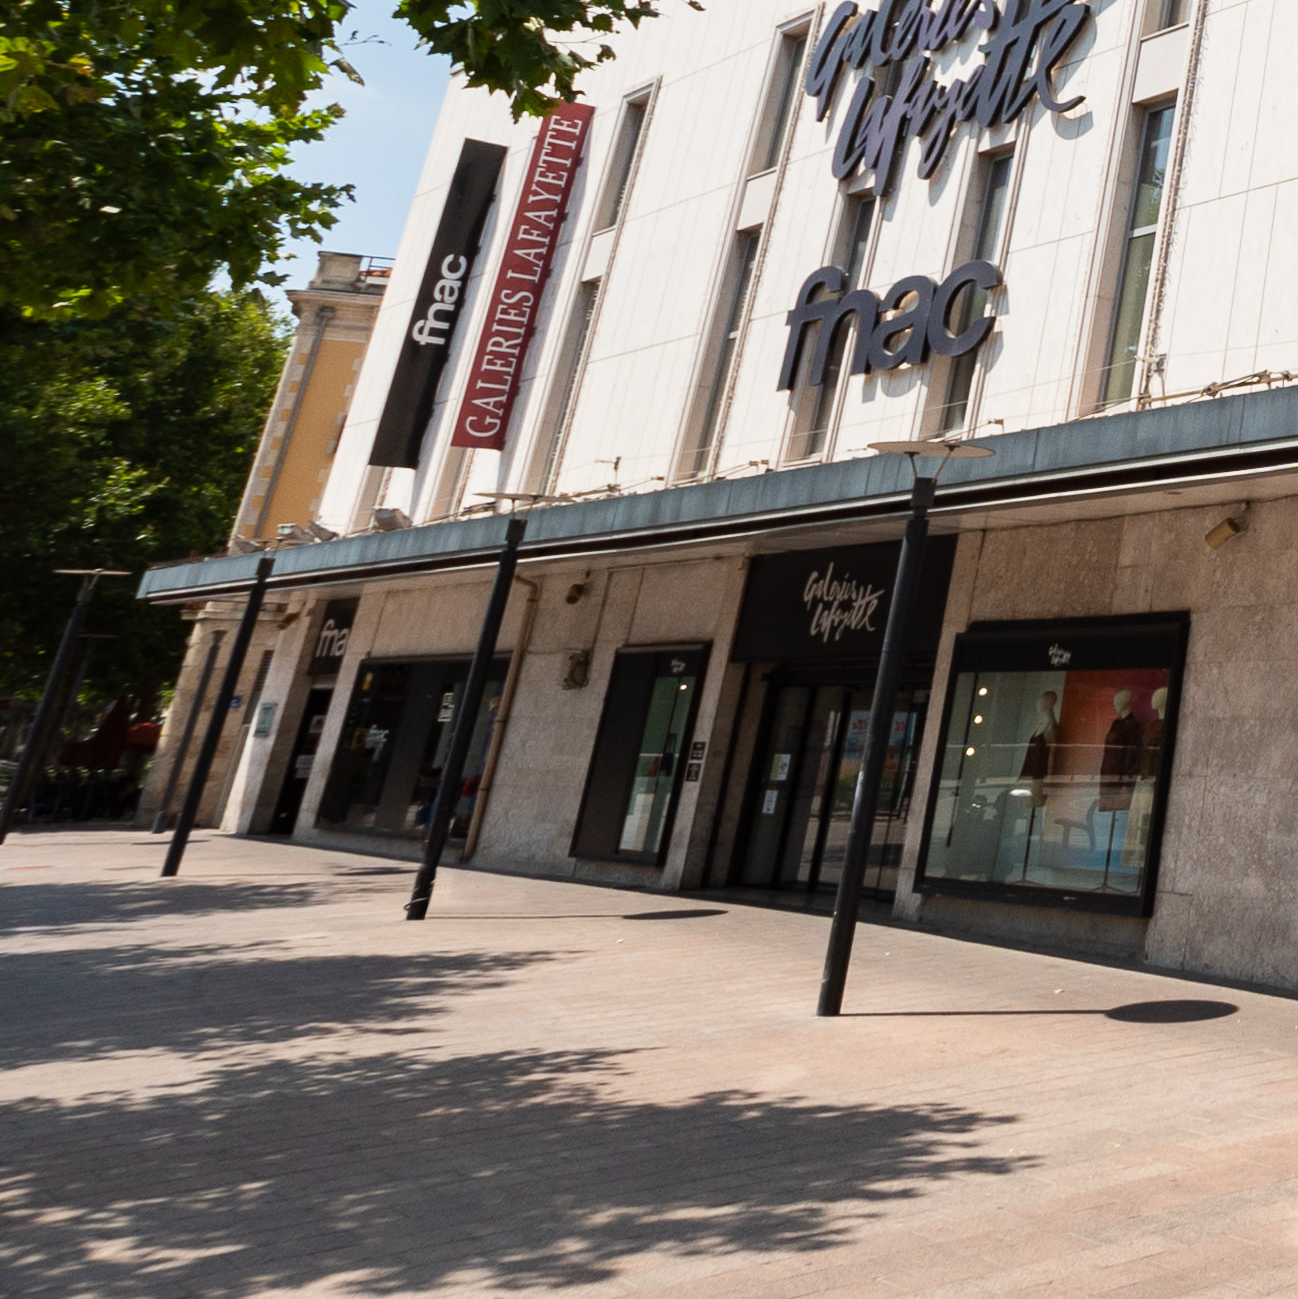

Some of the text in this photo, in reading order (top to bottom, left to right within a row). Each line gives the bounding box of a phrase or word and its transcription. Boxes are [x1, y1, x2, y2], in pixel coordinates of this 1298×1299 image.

[412, 253, 467, 345] fnac
[466, 114, 583, 438] GALERIES LAFAYETTE
[776, 259, 1003, 392] fnac
[315, 618, 350, 658] fna
